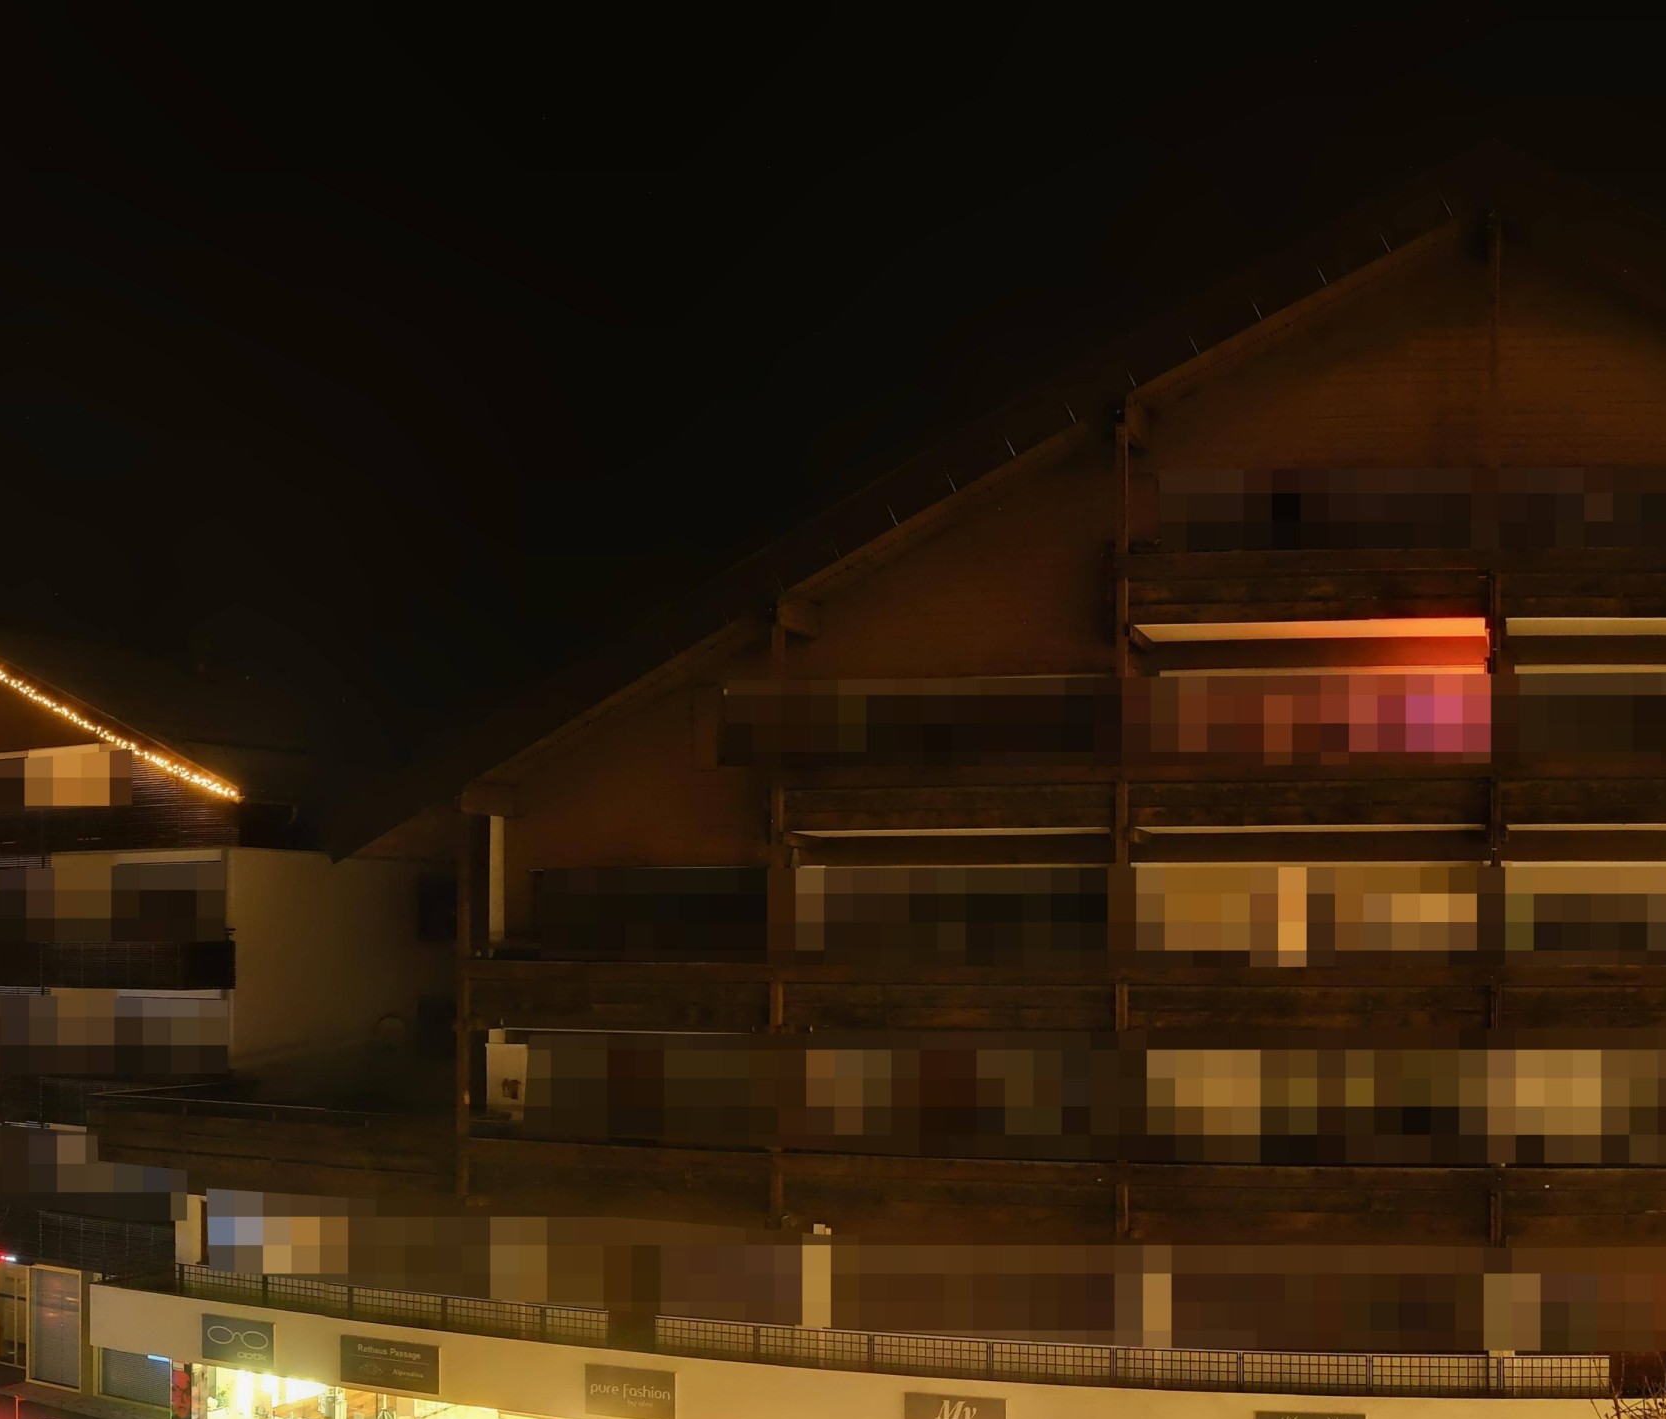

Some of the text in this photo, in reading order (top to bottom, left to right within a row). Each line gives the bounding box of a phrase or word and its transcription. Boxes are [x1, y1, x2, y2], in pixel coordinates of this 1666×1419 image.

[237, 1350, 268, 1362] optik
[357, 1343, 422, 1361] Rathaus Passage
[590, 1382, 671, 1401] pure fashion
